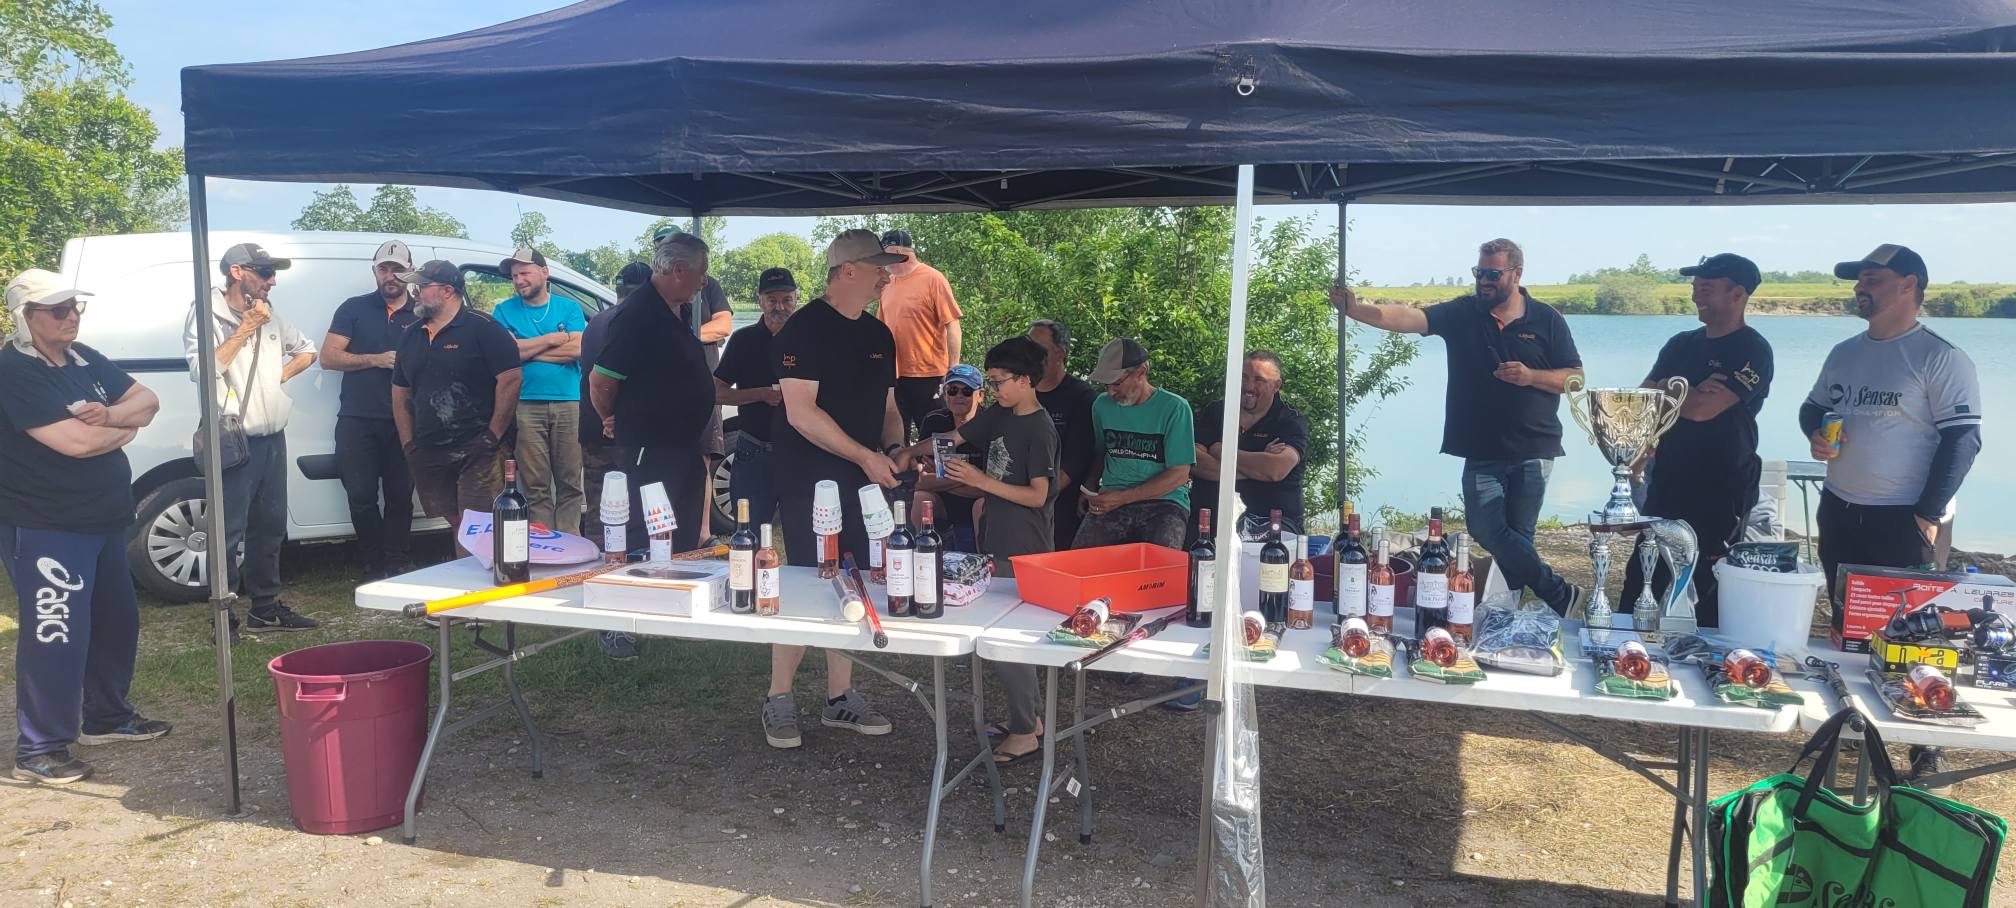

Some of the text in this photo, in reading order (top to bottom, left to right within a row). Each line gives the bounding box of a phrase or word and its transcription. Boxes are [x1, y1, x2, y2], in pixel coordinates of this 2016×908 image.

[1853, 385, 1903, 408] Sensas
[1740, 551, 1779, 565] Sensas
[36, 587, 70, 643] asics
